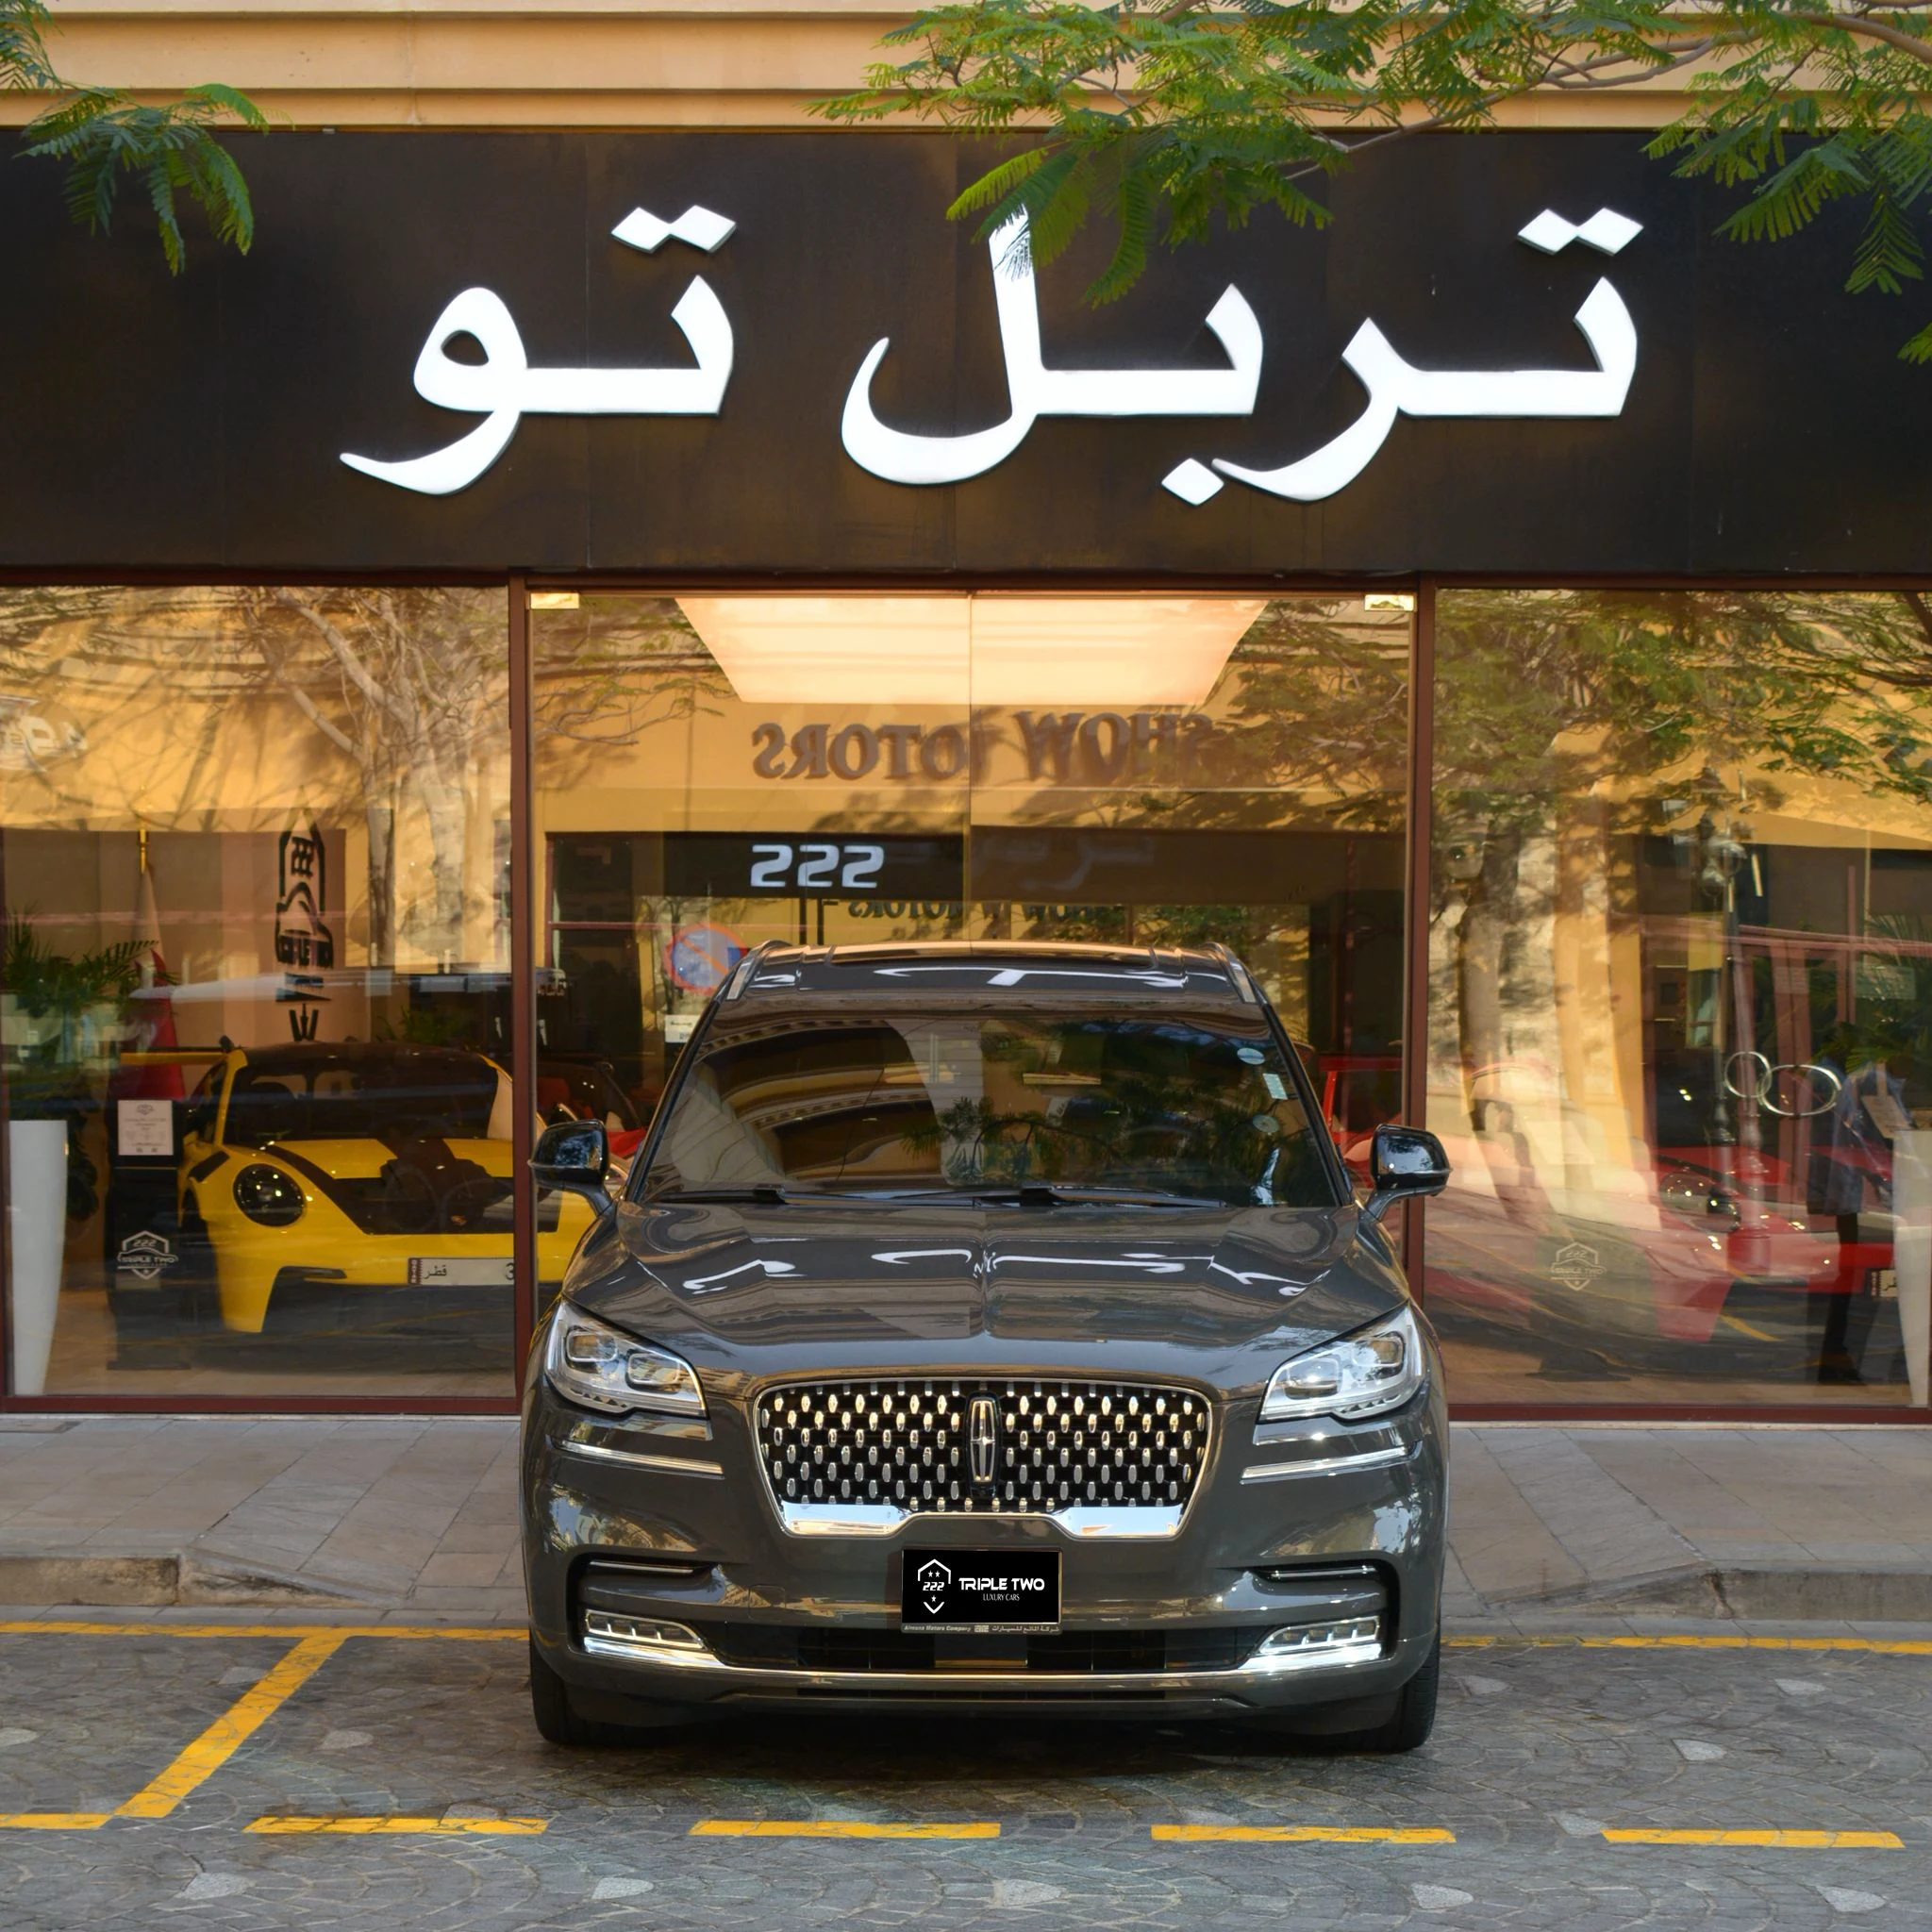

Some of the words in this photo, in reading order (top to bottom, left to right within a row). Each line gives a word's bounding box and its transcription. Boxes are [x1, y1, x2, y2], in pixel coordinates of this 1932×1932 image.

[340, 205, 736, 494] تو
[751, 843, 885, 888] 222
[424, 1264, 447, 1279] قطر
[923, 1581, 944, 1591] 222
[958, 1577, 1008, 1591] TRIPLE
[1011, 1577, 1045, 1591] TWO
